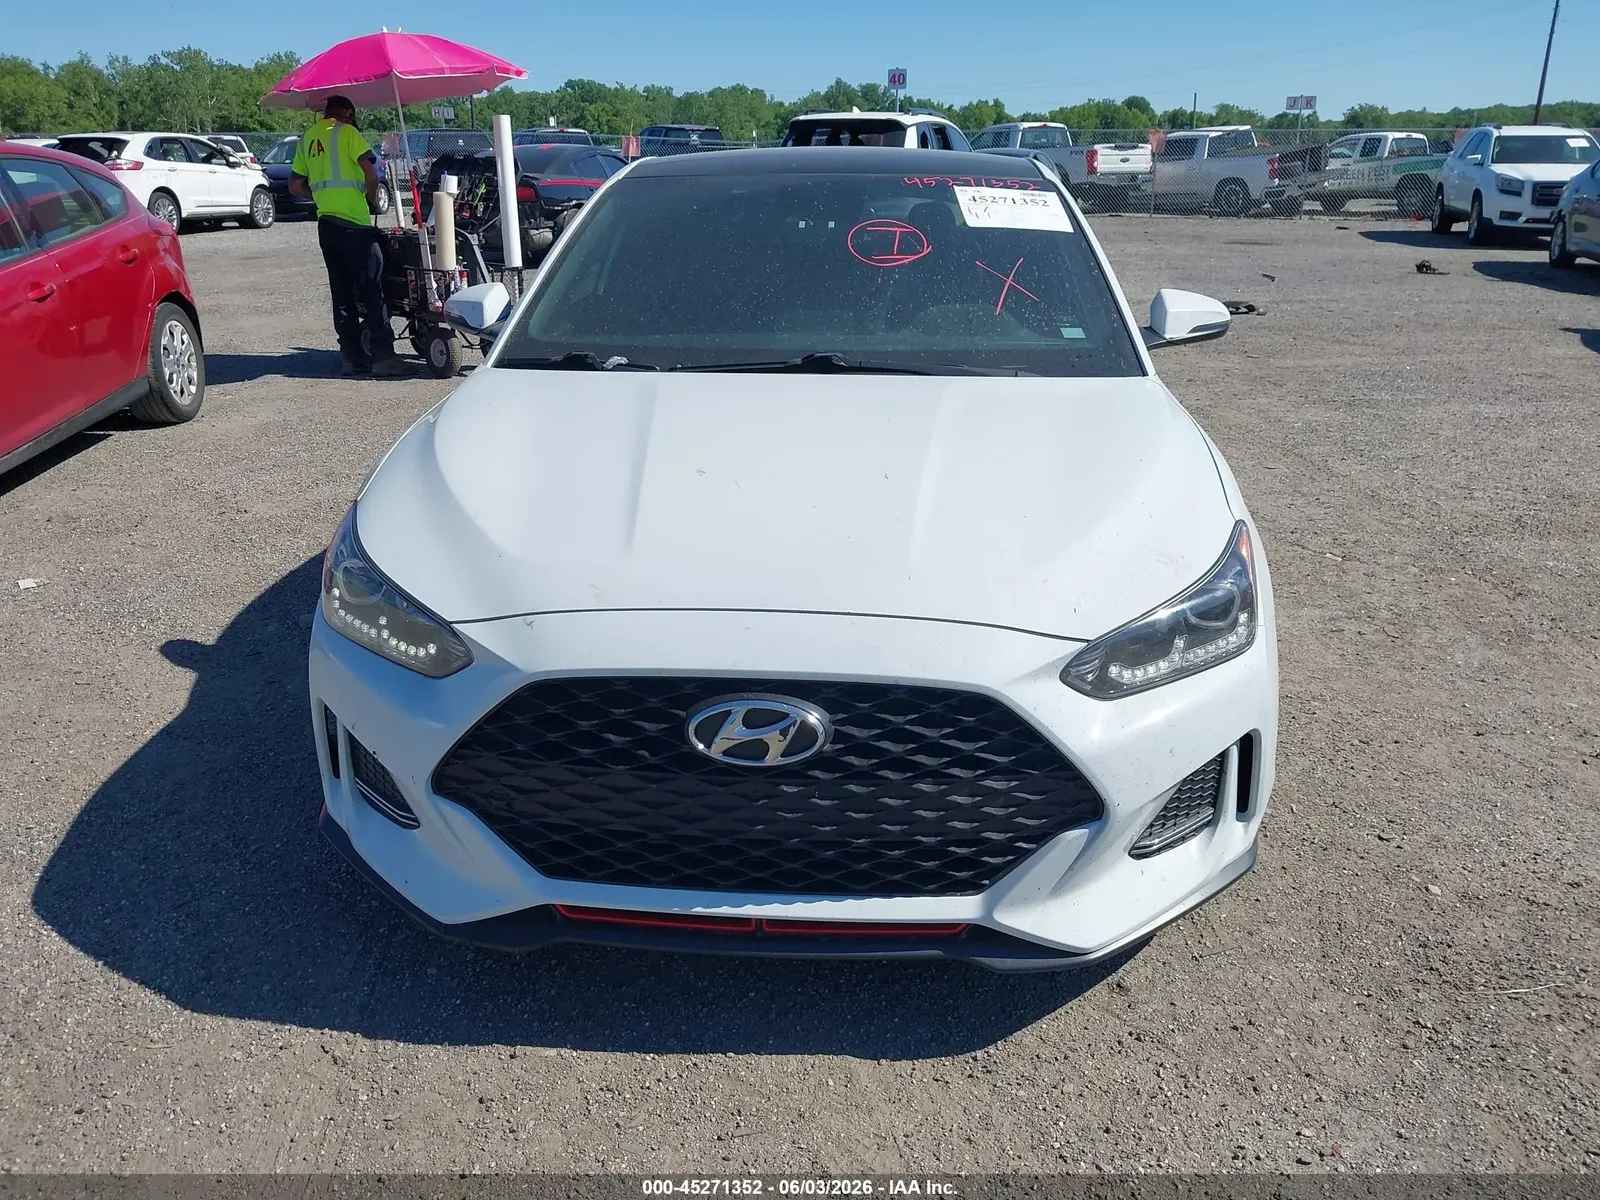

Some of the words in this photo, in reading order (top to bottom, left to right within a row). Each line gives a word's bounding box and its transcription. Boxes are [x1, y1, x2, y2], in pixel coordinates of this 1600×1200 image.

[890, 73, 906, 85] 40
[1305, 98, 1313, 107] K
[903, 176, 1041, 190] 45271352
[968, 195, 1050, 207] 45271352
